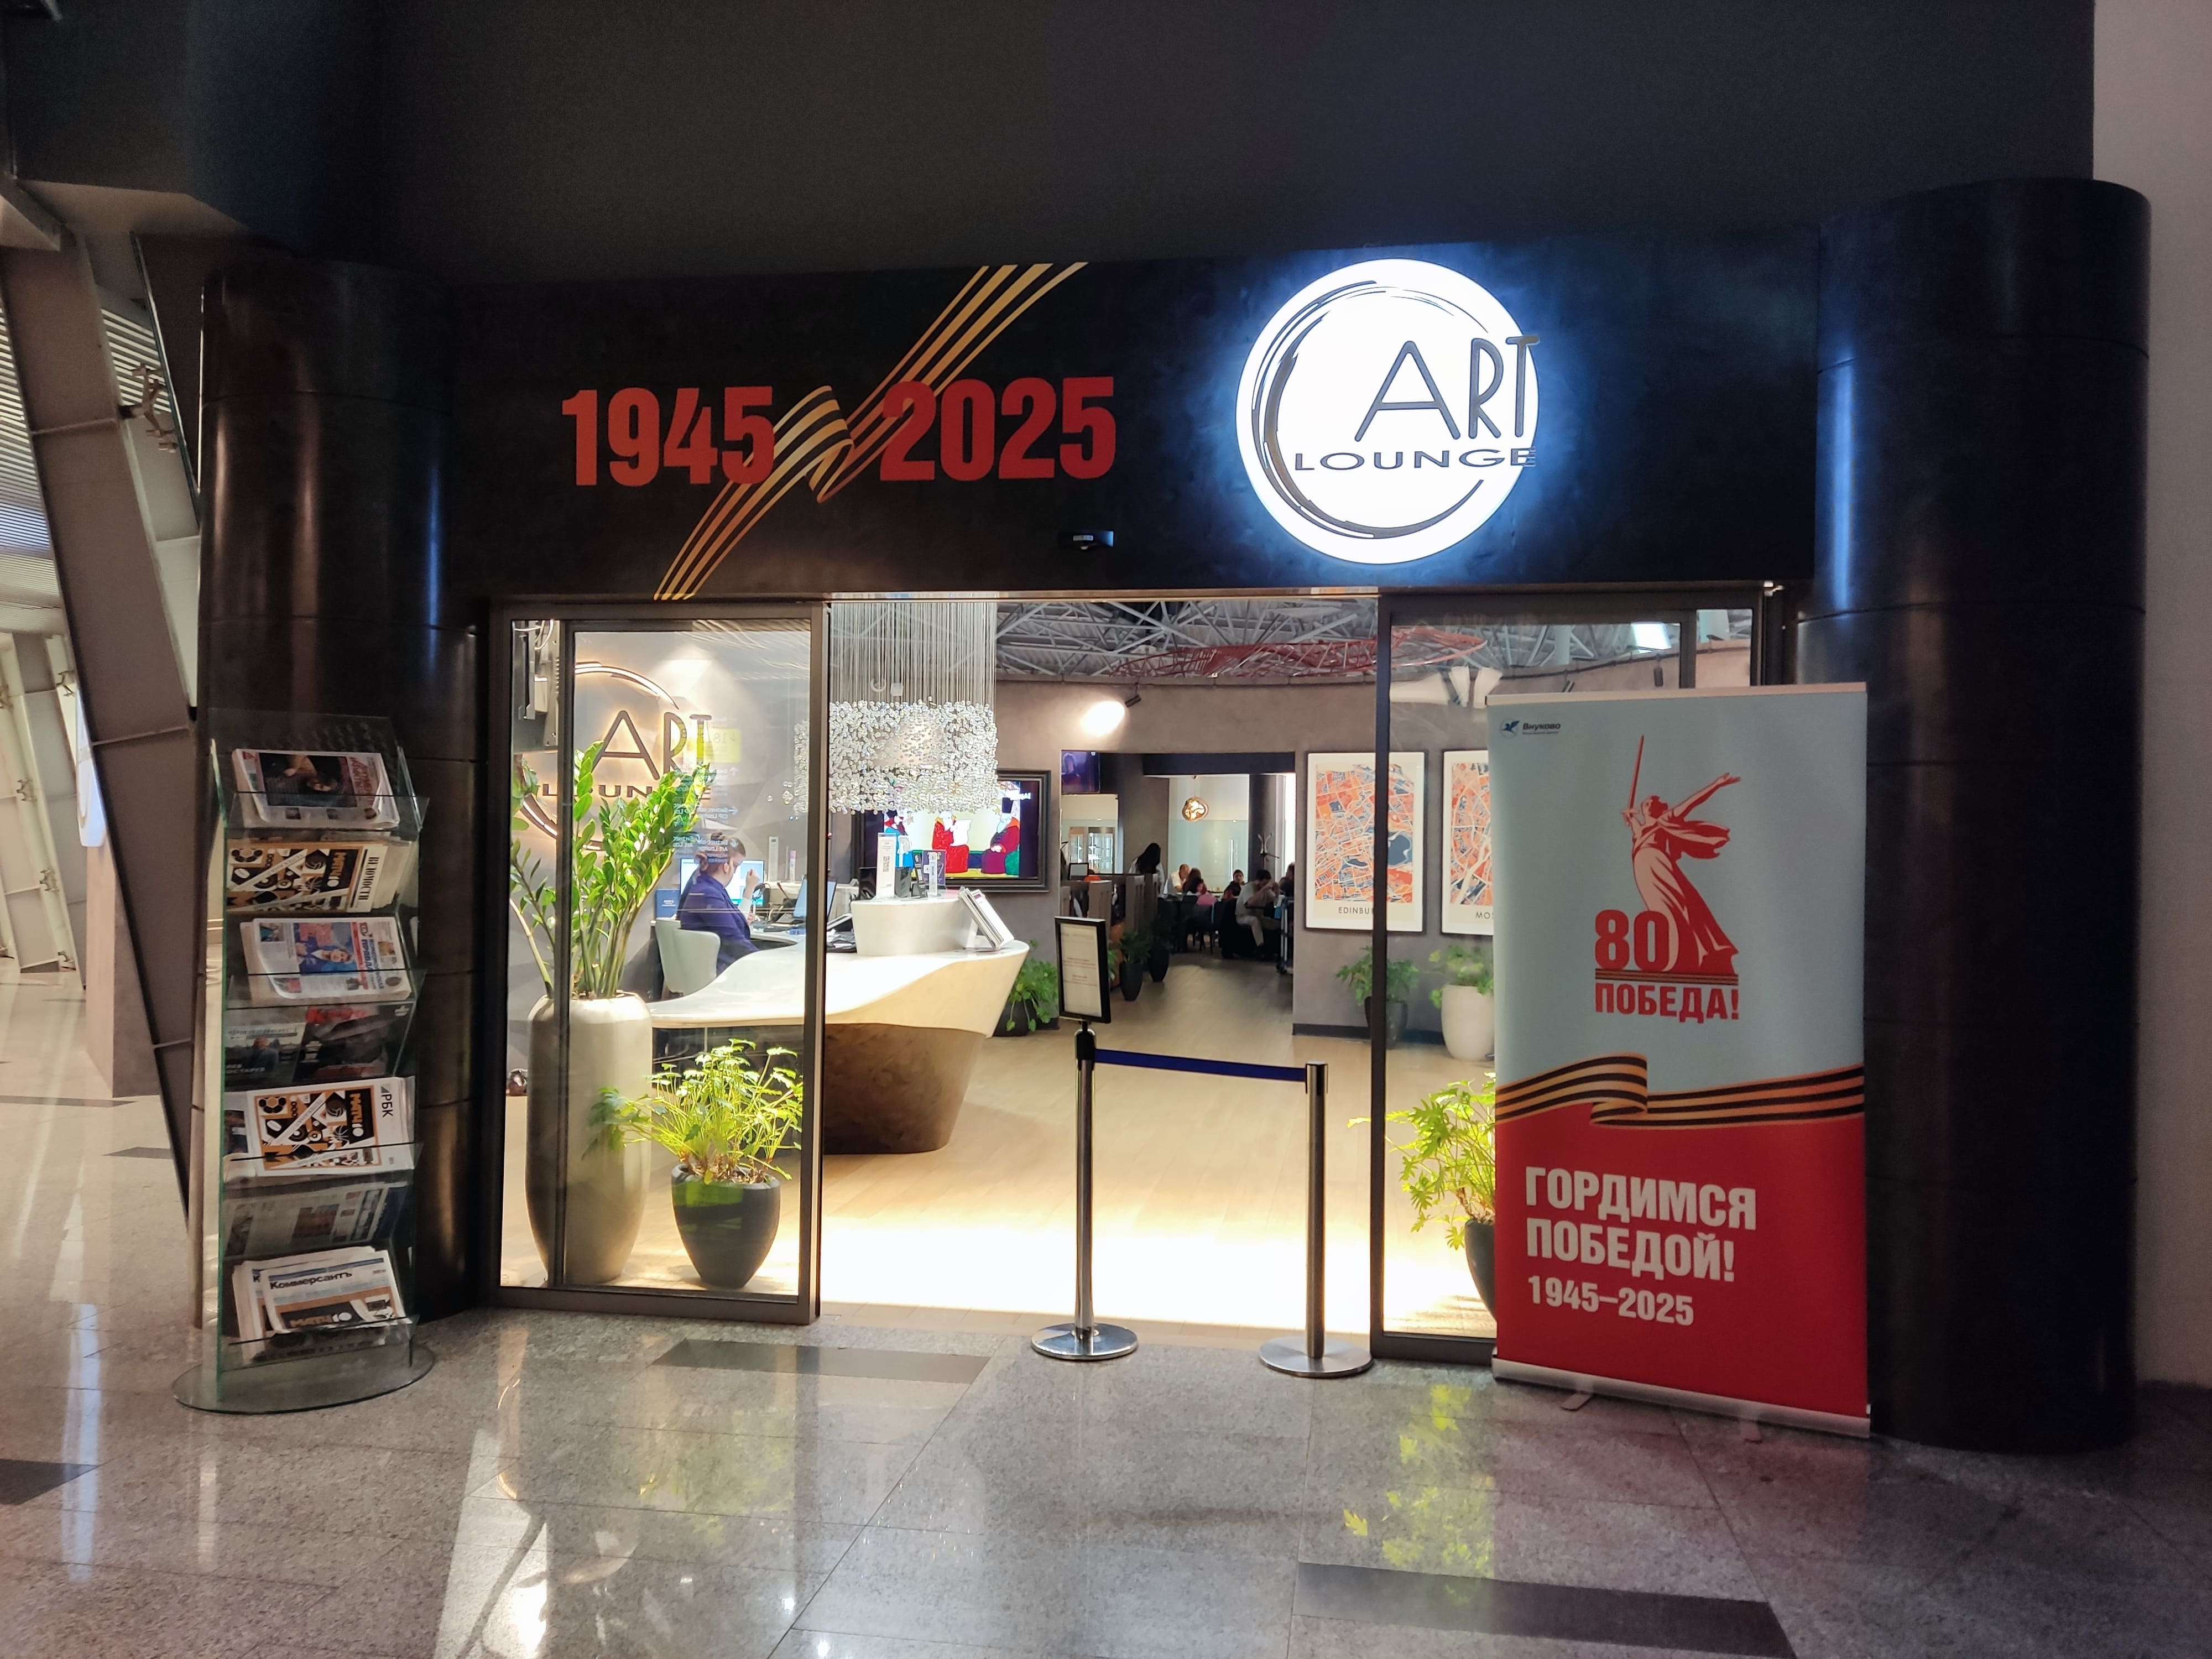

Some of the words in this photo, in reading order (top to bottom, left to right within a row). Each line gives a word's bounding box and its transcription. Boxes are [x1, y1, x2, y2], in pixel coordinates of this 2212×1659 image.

[1354, 335, 1541, 442] ART
[561, 385, 775, 487] 1945
[879, 376, 1117, 482] 2025
[1294, 446, 1537, 471] LOUNGE
[1522, 722, 1561, 731] Внуково
[1338, 906, 1374, 915] EDINBU
[1475, 911, 1494, 920] MO
[1594, 909, 1671, 972] 80
[1595, 983, 1740, 1024] ПОБЕДА!
[381, 1093, 394, 1118] РБК
[1525, 1166, 1757, 1231] ГОРДИМСЯ
[1526, 1218, 1735, 1282] ПОБЕДОЙ!
[270, 1271, 353, 1290] Коммерсантъ
